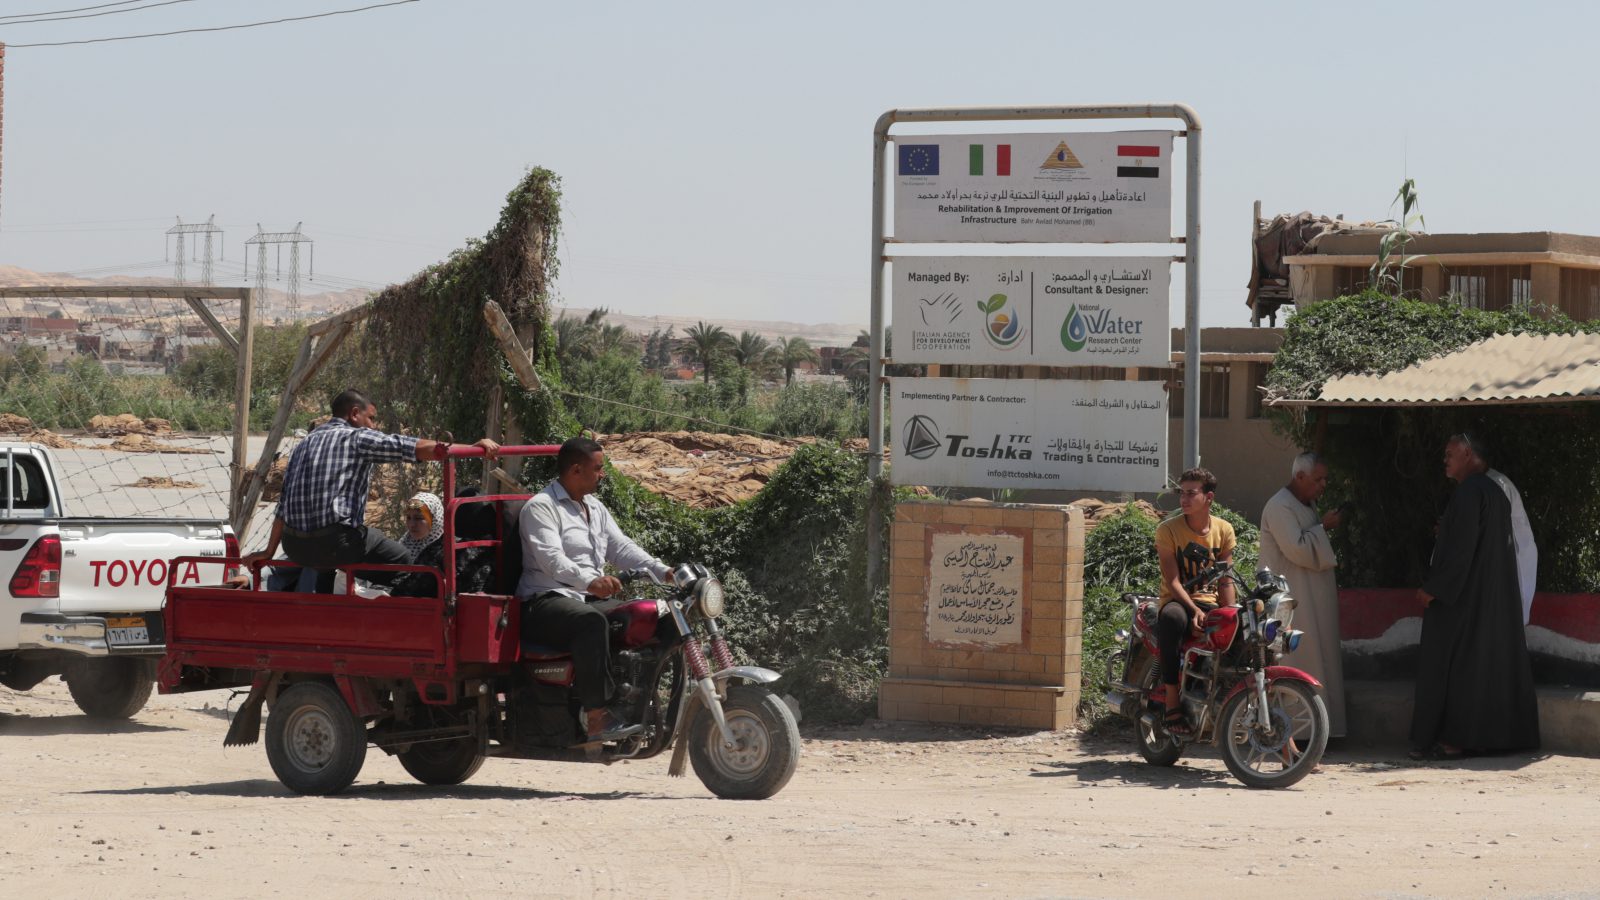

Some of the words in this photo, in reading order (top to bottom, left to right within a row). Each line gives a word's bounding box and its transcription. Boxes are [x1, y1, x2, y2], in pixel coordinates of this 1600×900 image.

[960, 192, 972, 200] بحر
[973, 190, 988, 201] ترعة
[990, 190, 1008, 201] للري
[1010, 190, 1040, 202] التحتية
[1042, 190, 1064, 202] البنية
[1066, 192, 1089, 202] تطوير
[938, 204, 993, 212] Rehabilitation
[1004, 206, 1058, 214] Improvement
[1073, 206, 1112, 216] Irrigation
[961, 216, 1016, 224] Infrastructure
[908, 272, 952, 284] Managed
[954, 272, 969, 284] By:
[1052, 269, 1091, 282] المصمم:
[1093, 274, 1098, 283] و
[1101, 269, 1152, 283] الاستشاري
[1045, 285, 1094, 294] Consultant
[1096, 286, 1104, 294] &
[1105, 285, 1148, 296] Designer:
[1078, 304, 1100, 312] National
[1084, 308, 1143, 334] Water
[1088, 336, 1118, 344] Research
[902, 392, 950, 402] Implementing
[952, 393, 978, 402] Partner
[986, 395, 1026, 404] Contractor:
[1098, 398, 1124, 410] الشريك
[1131, 399, 1160, 410] المقاول
[1009, 434, 1032, 444] TTC
[1047, 437, 1090, 452] والمقاولات
[1094, 437, 1124, 452] للتجارة
[945, 434, 1032, 460] Toshka
[1129, 438, 1158, 455] توشكا
[1043, 452, 1083, 464] Trading
[1086, 454, 1094, 462] &
[1096, 454, 1160, 467] Contracting
[987, 470, 1060, 480] info@ttctoshka.com
[969, 551, 996, 568] الفتاح
[992, 556, 1014, 572] عبد
[90, 558, 200, 587] TOYOA
[977, 597, 990, 610] حجر
[989, 598, 1004, 610] وضع
[1006, 598, 1014, 614] تم
[1000, 612, 1015, 625] تطوير
